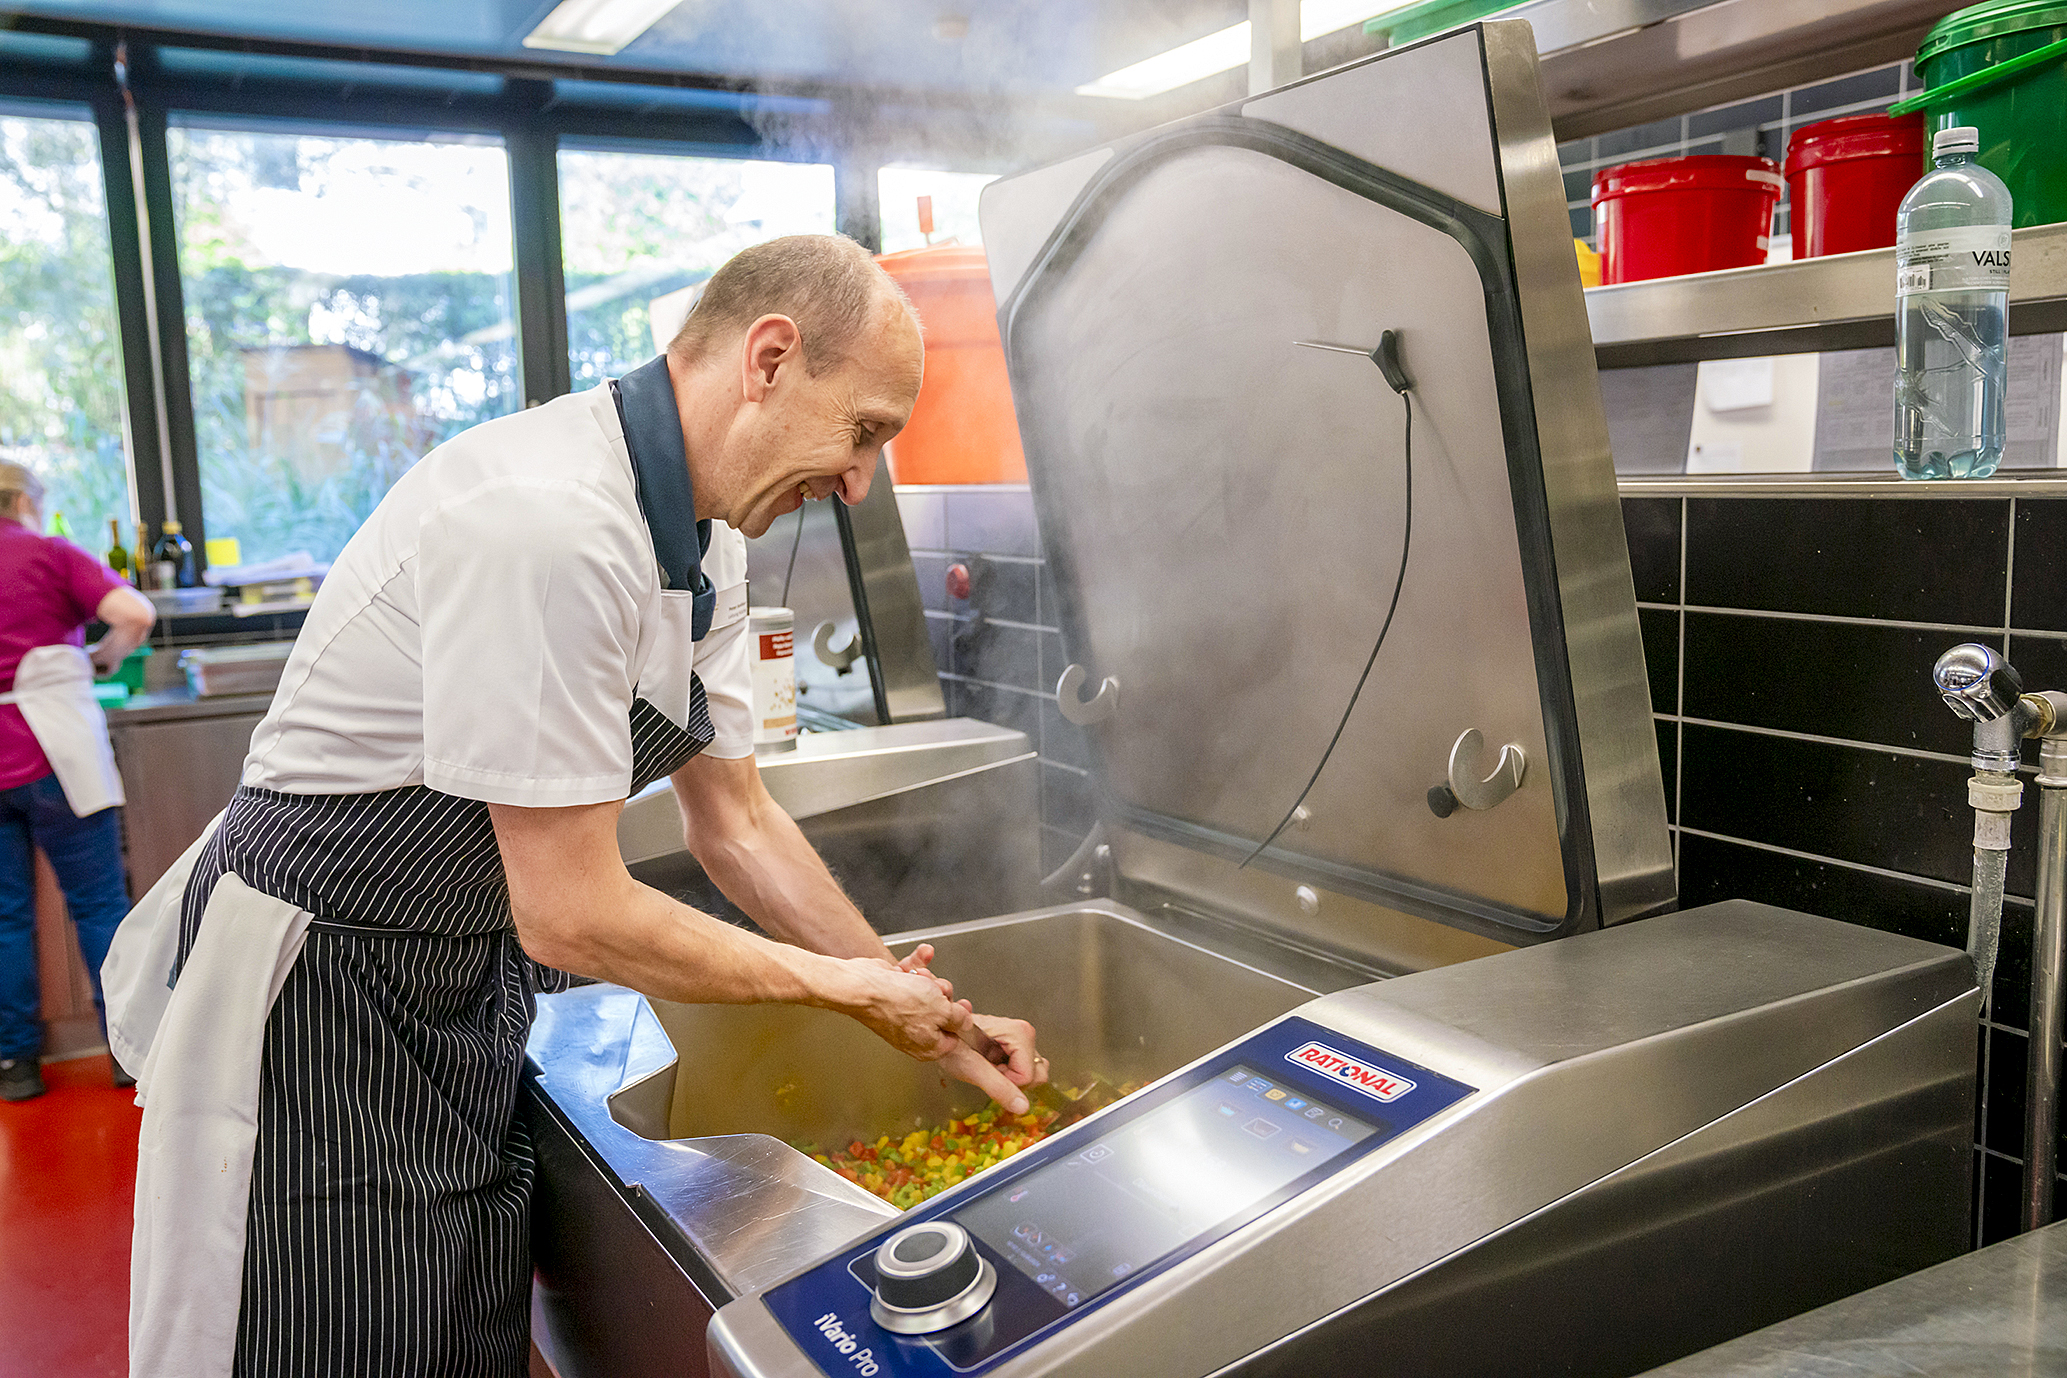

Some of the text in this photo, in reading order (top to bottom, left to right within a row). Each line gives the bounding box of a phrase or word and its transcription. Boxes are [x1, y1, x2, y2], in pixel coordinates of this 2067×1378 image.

[1298, 1048, 1397, 1095] RATIONAL
[814, 1312, 879, 1377] iVario Pro
